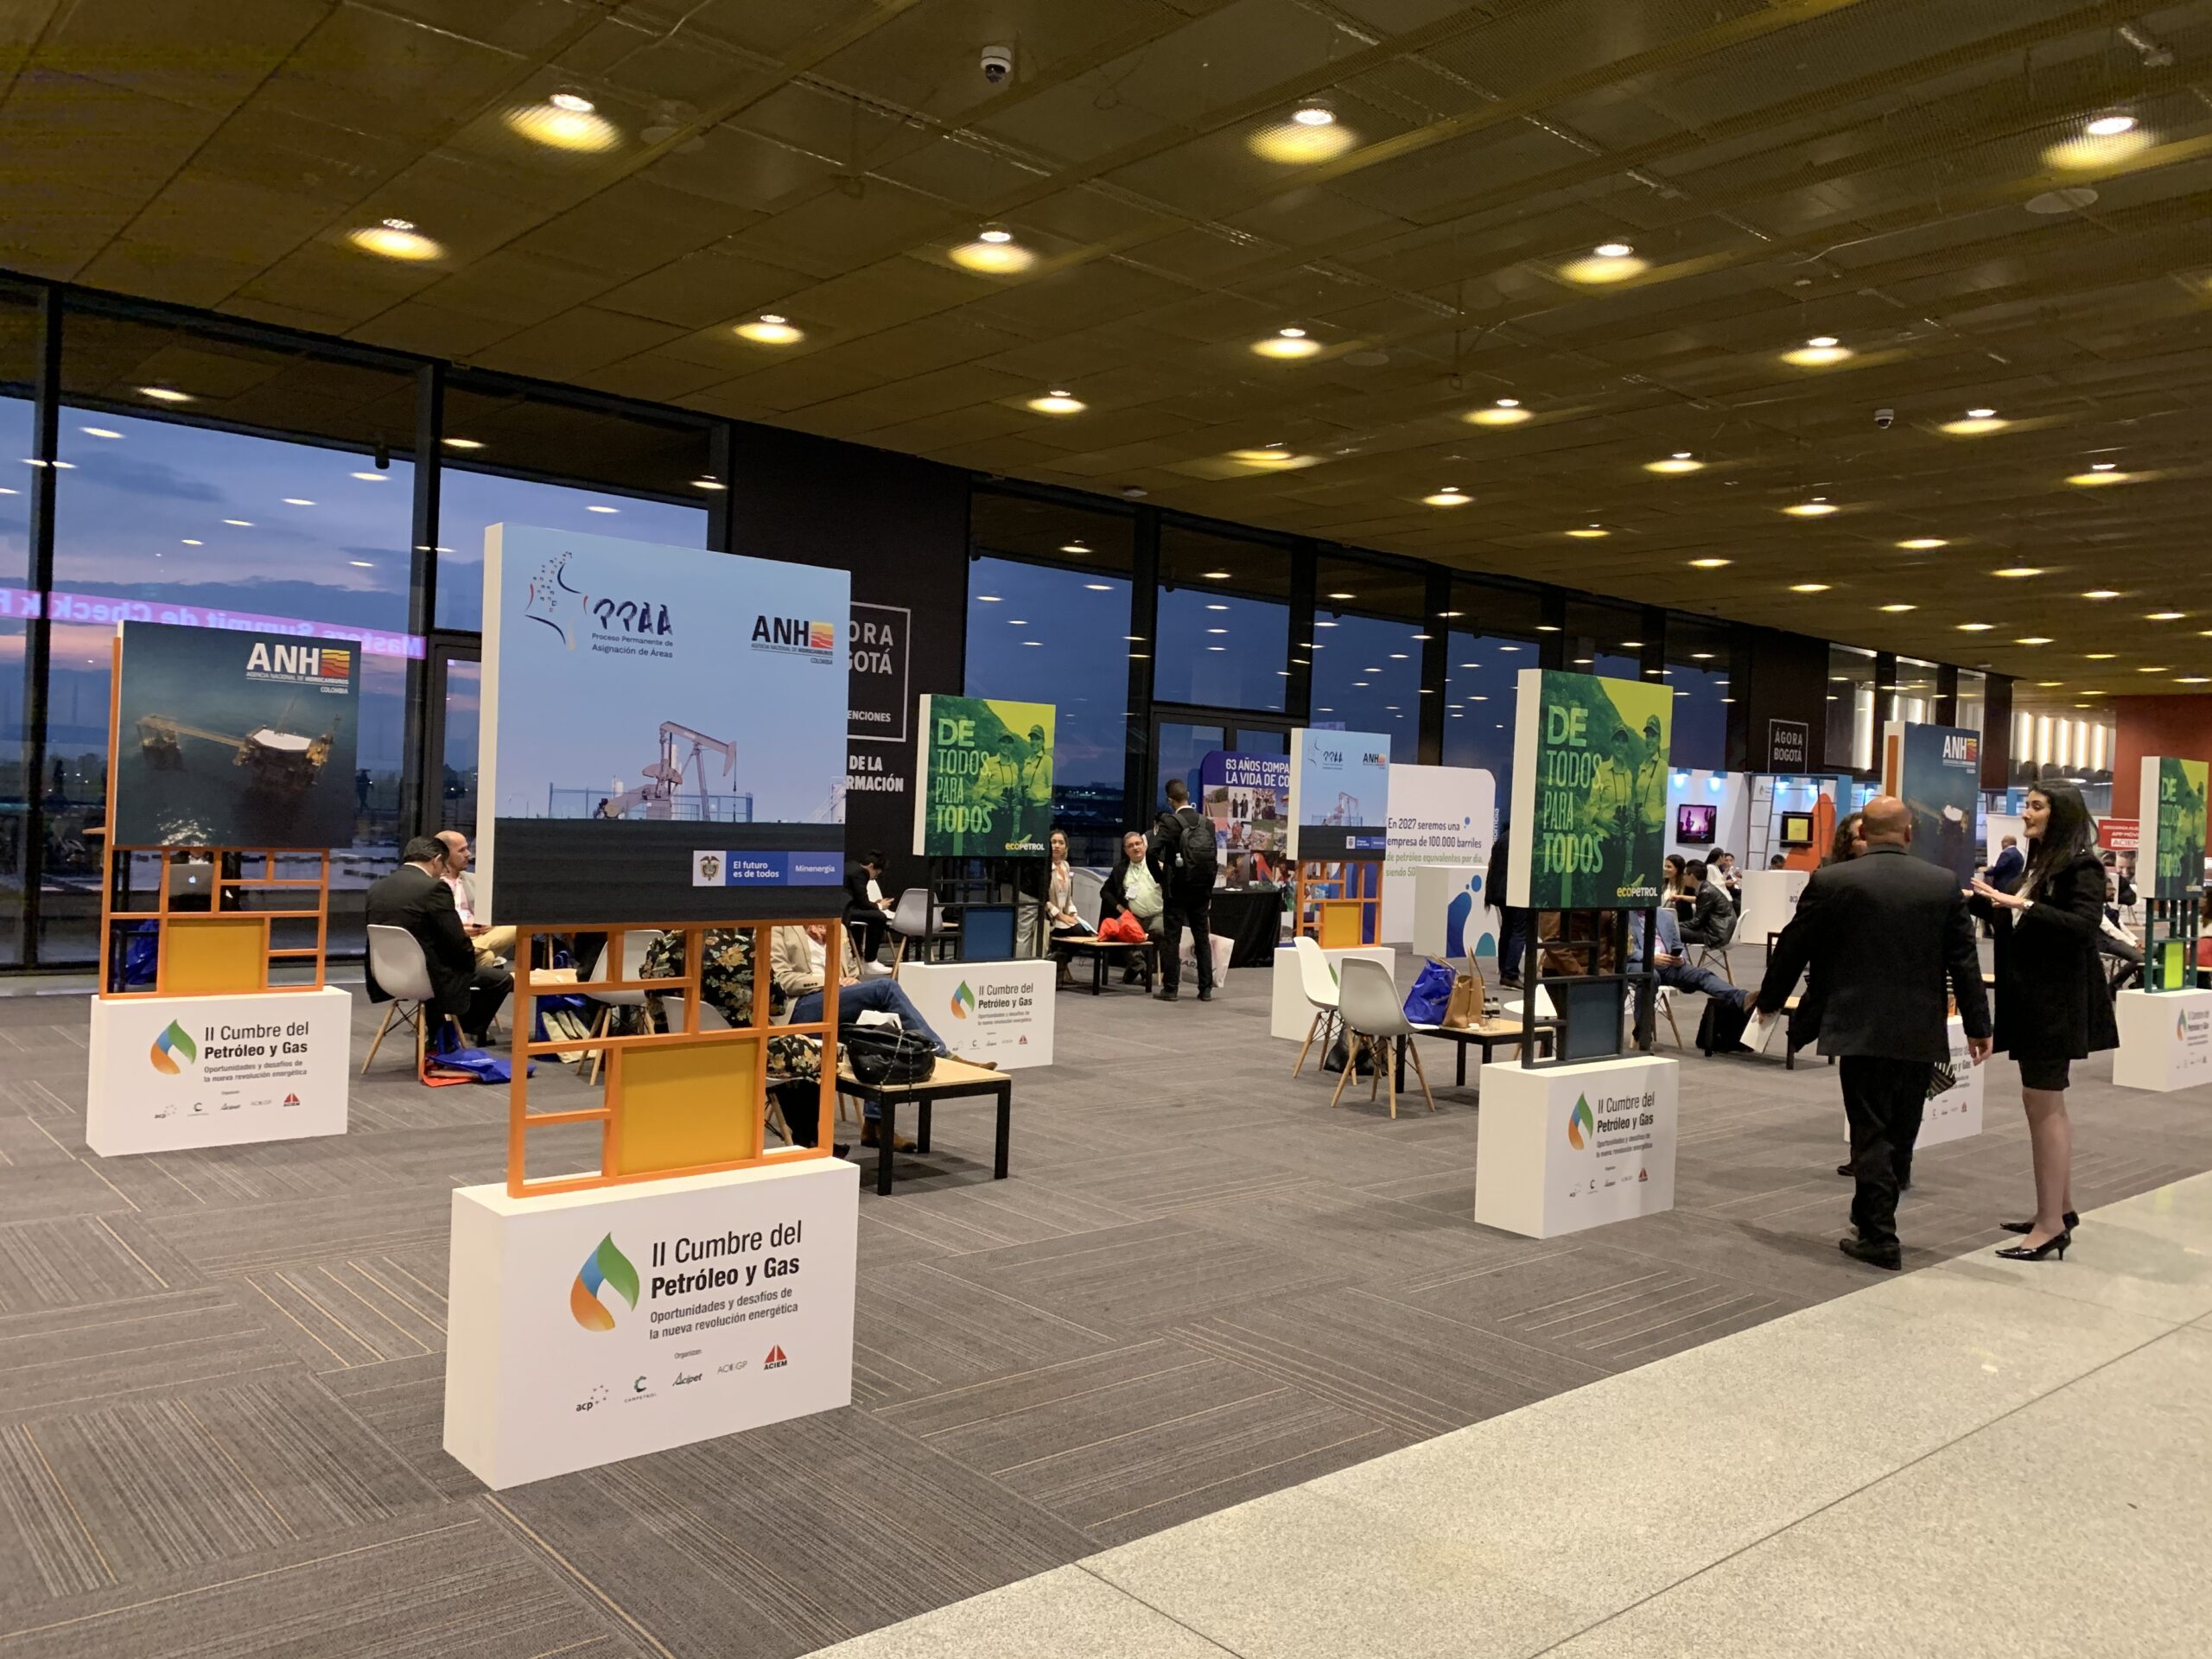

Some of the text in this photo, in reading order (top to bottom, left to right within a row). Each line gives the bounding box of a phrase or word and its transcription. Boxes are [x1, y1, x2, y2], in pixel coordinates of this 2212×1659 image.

[752, 615, 809, 646] ANH
[622, 636, 663, 646] Permanente
[246, 643, 320, 676] ANH
[593, 644, 636, 654] Asignación
[651, 648, 673, 658] Áreas
[938, 718, 976, 747] DE
[1547, 705, 1588, 747] DE
[1775, 728, 1803, 747] ÁGORA
[1774, 746, 1802, 762] BOGOTÁ
[1942, 735, 1967, 760] ANH
[849, 755, 883, 771] DE LA
[1226, 759, 1236, 770] 63
[1238, 757, 1261, 772] AÑOS
[1363, 753, 1379, 763] ANH
[1226, 771, 1238, 785] LA
[1241, 772, 1262, 785] VIDA
[1264, 774, 1276, 786] DE
[936, 777, 964, 804] PARA
[2162, 778, 2177, 802] DE
[1544, 791, 1573, 830] PARA
[936, 805, 993, 834] TODOS
[1389, 817, 1397, 829] En
[1399, 818, 1417, 830] 2027
[1388, 837, 1417, 849] empresa
[1419, 836, 1427, 846] de
[1429, 836, 1455, 847] 100.000
[1457, 837, 1482, 849] barriles
[1387, 852, 1395, 861] de
[1395, 853, 1421, 863] petróleo
[1543, 833, 1604, 874] TODOS
[796, 864, 836, 874] Minenergía
[979, 982, 1033, 995] II Cumbre del
[979, 997, 1033, 1009] Petróleo y Gas
[206, 1021, 308, 1041] II Cumbre del
[205, 1042, 308, 1059] Petróleo y Gas
[204, 1065, 256, 1074] Oportunidades
[235, 1071, 270, 1080] revolución
[1599, 1091, 1656, 1114] II Cumbre del
[1598, 1113, 1654, 1134] Petróleo y Gas
[652, 1220, 802, 1268] II Cumbre del
[652, 1257, 800, 1300] Petróleo y Gas
[651, 1287, 792, 1325] Oportunidades y desafíos de
[650, 1304, 798, 1340] la nueva revolución energética
[764, 1361, 788, 1370] ACIEM
[672, 1371, 703, 1387] Acipet
[576, 1402, 594, 1412] acp
